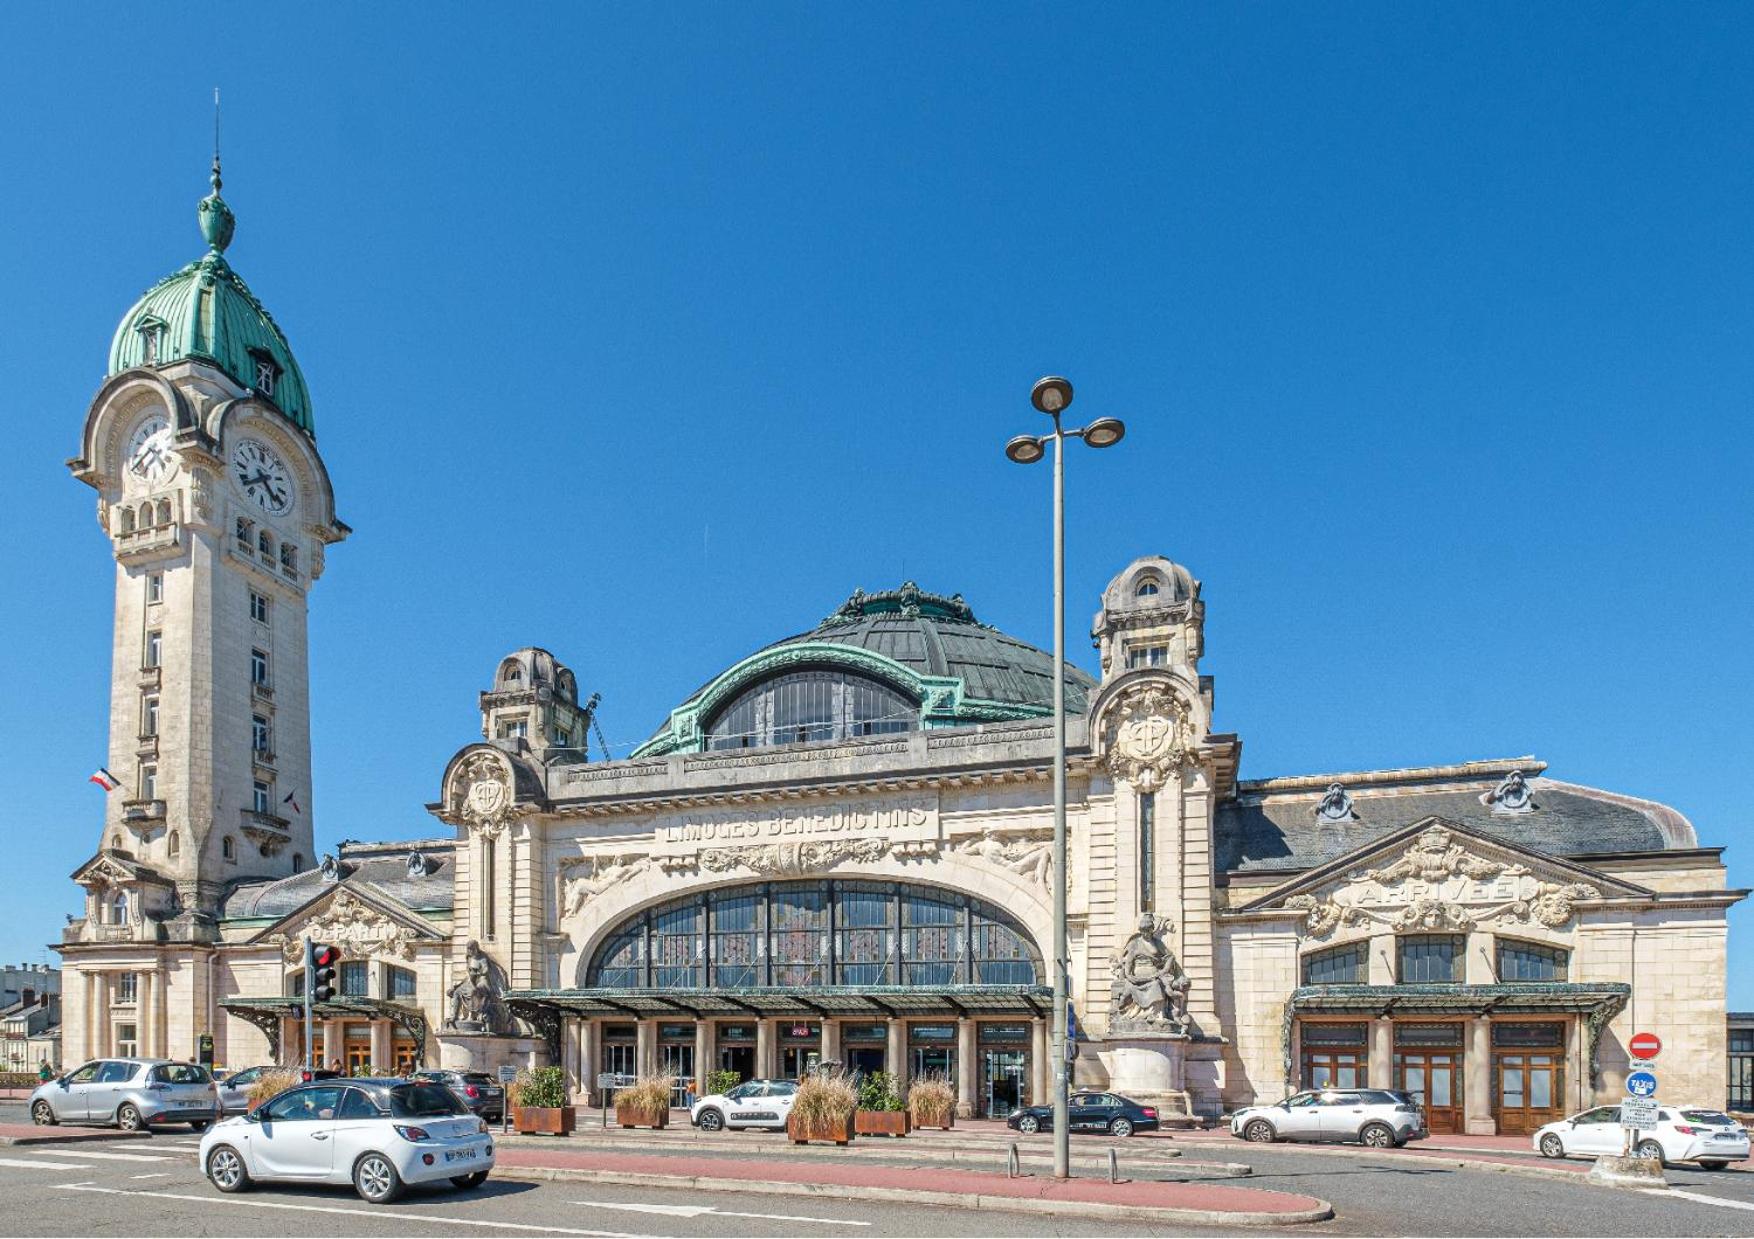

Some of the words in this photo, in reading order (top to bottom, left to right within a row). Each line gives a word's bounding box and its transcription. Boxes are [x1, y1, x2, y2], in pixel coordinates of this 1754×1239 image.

[665, 811, 760, 843] LIMOGES
[767, 800, 927, 836] BENEDICTINS
[1631, 1079, 1655, 1089] TAXIS
